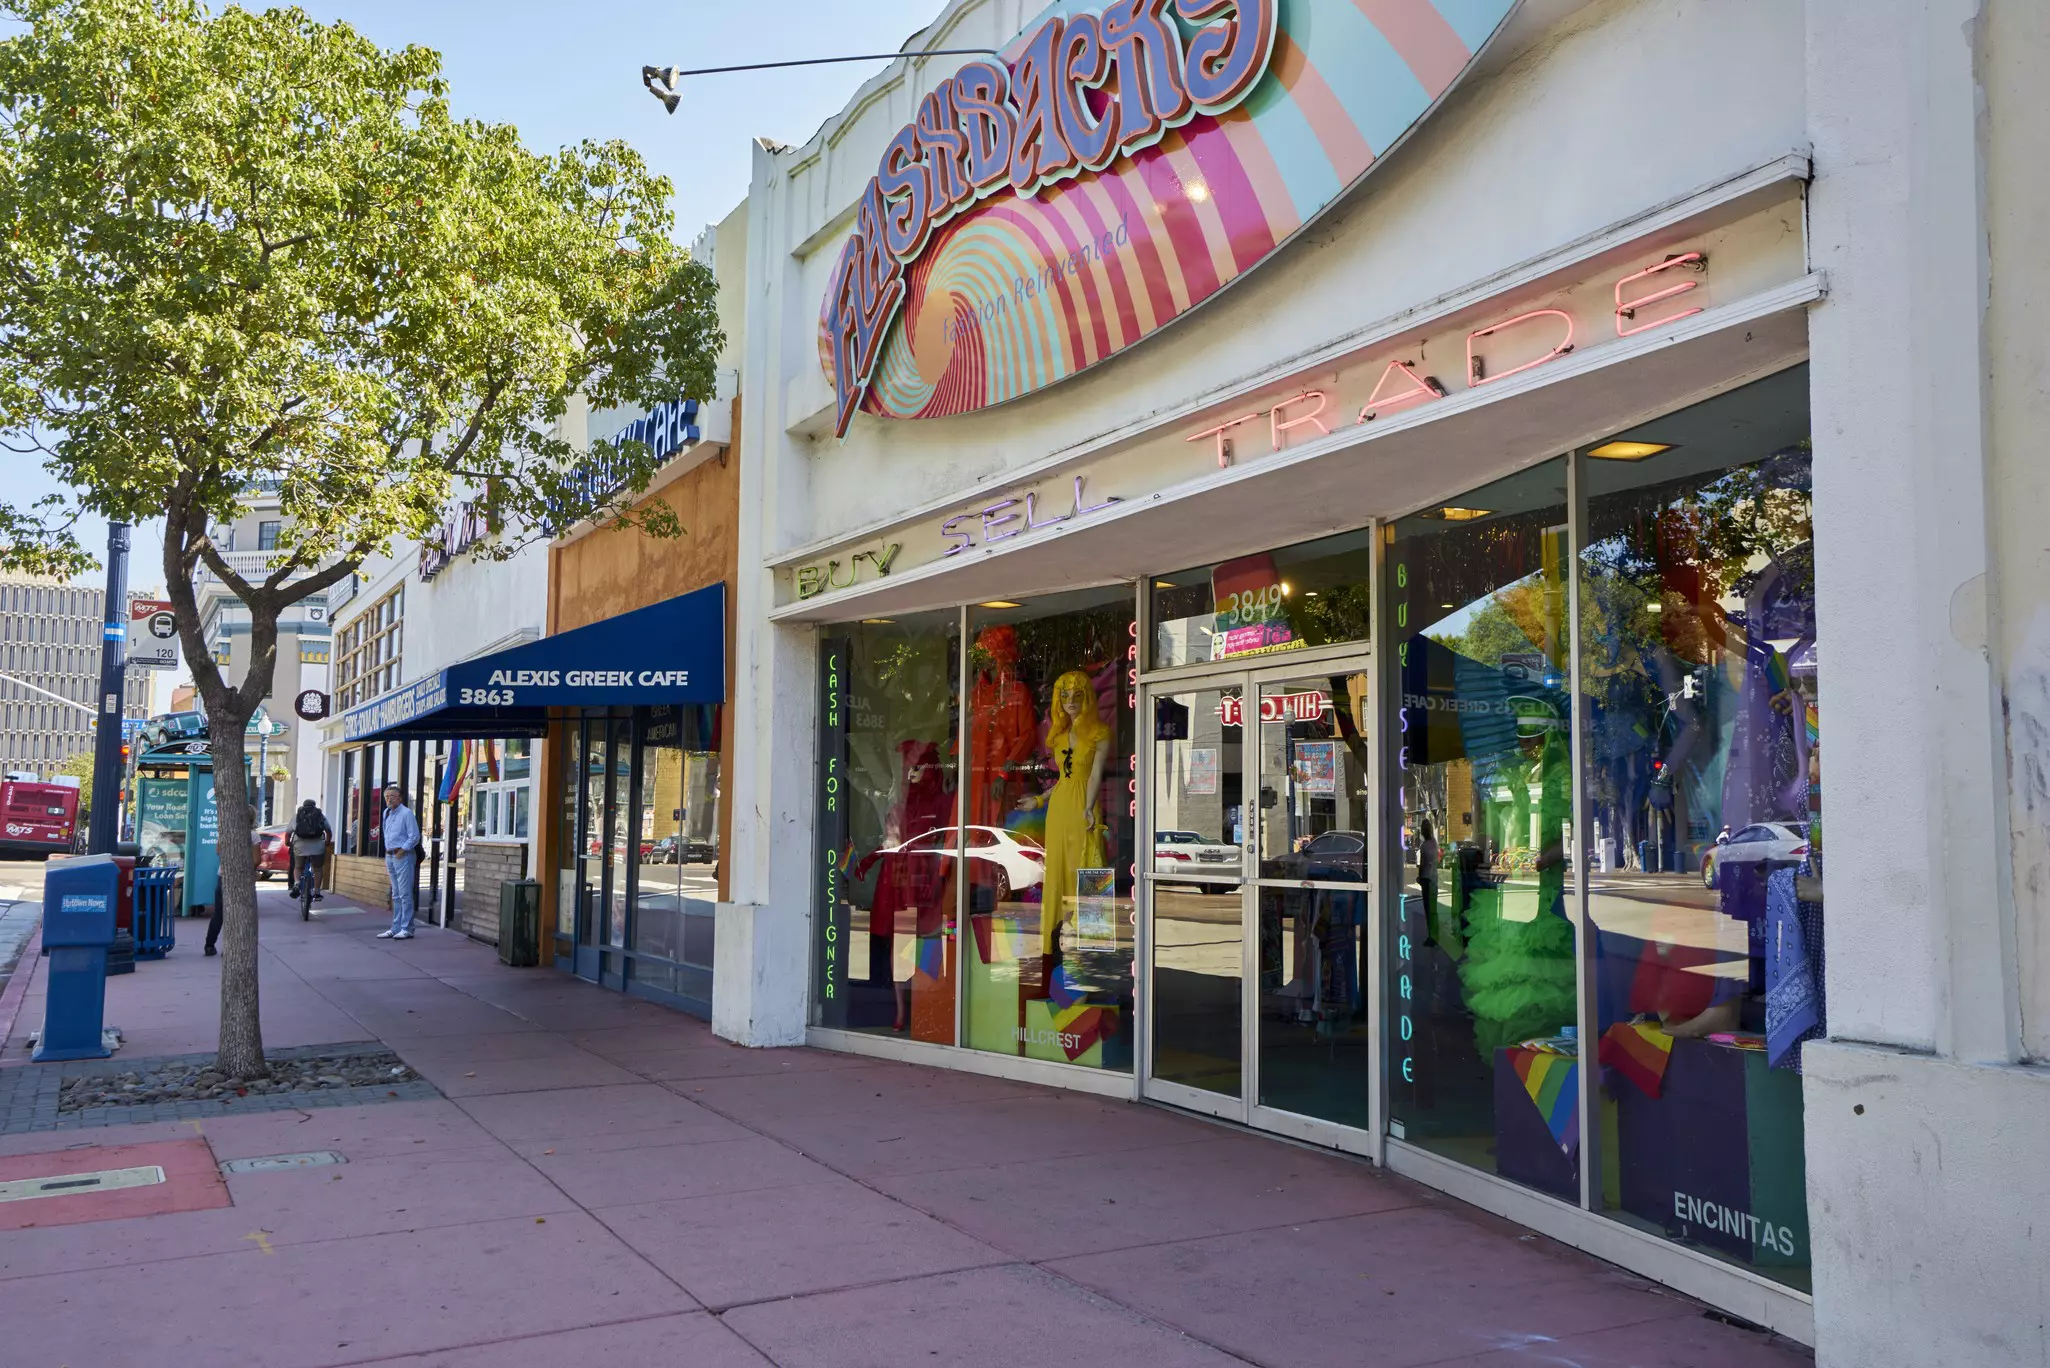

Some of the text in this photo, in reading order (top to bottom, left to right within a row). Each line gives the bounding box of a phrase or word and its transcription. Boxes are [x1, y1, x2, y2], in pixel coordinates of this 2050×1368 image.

[827, 0, 1279, 438] FLASHBACKS
[1014, 212, 1128, 306] Reinvented
[1185, 252, 1707, 469] TRADE
[942, 476, 1123, 556] SELL
[797, 543, 900, 599] BUY
[1228, 583, 1282, 625] 3849
[1397, 563, 1408, 668] BUY
[133, 638, 137, 646] 1
[156, 649, 174, 658] 120
[460, 688, 514, 706] 3863
[488, 670, 689, 687] ALEXIS GREEK CAFE
[6, 824, 34, 836] MTS
[826, 655, 838, 999] CASH FOR DESIGNER
[1399, 894, 1413, 1083] TRADE
[1011, 1024, 1081, 1049] HILLCREST
[1674, 1191, 1794, 1256] ENCINITAS
